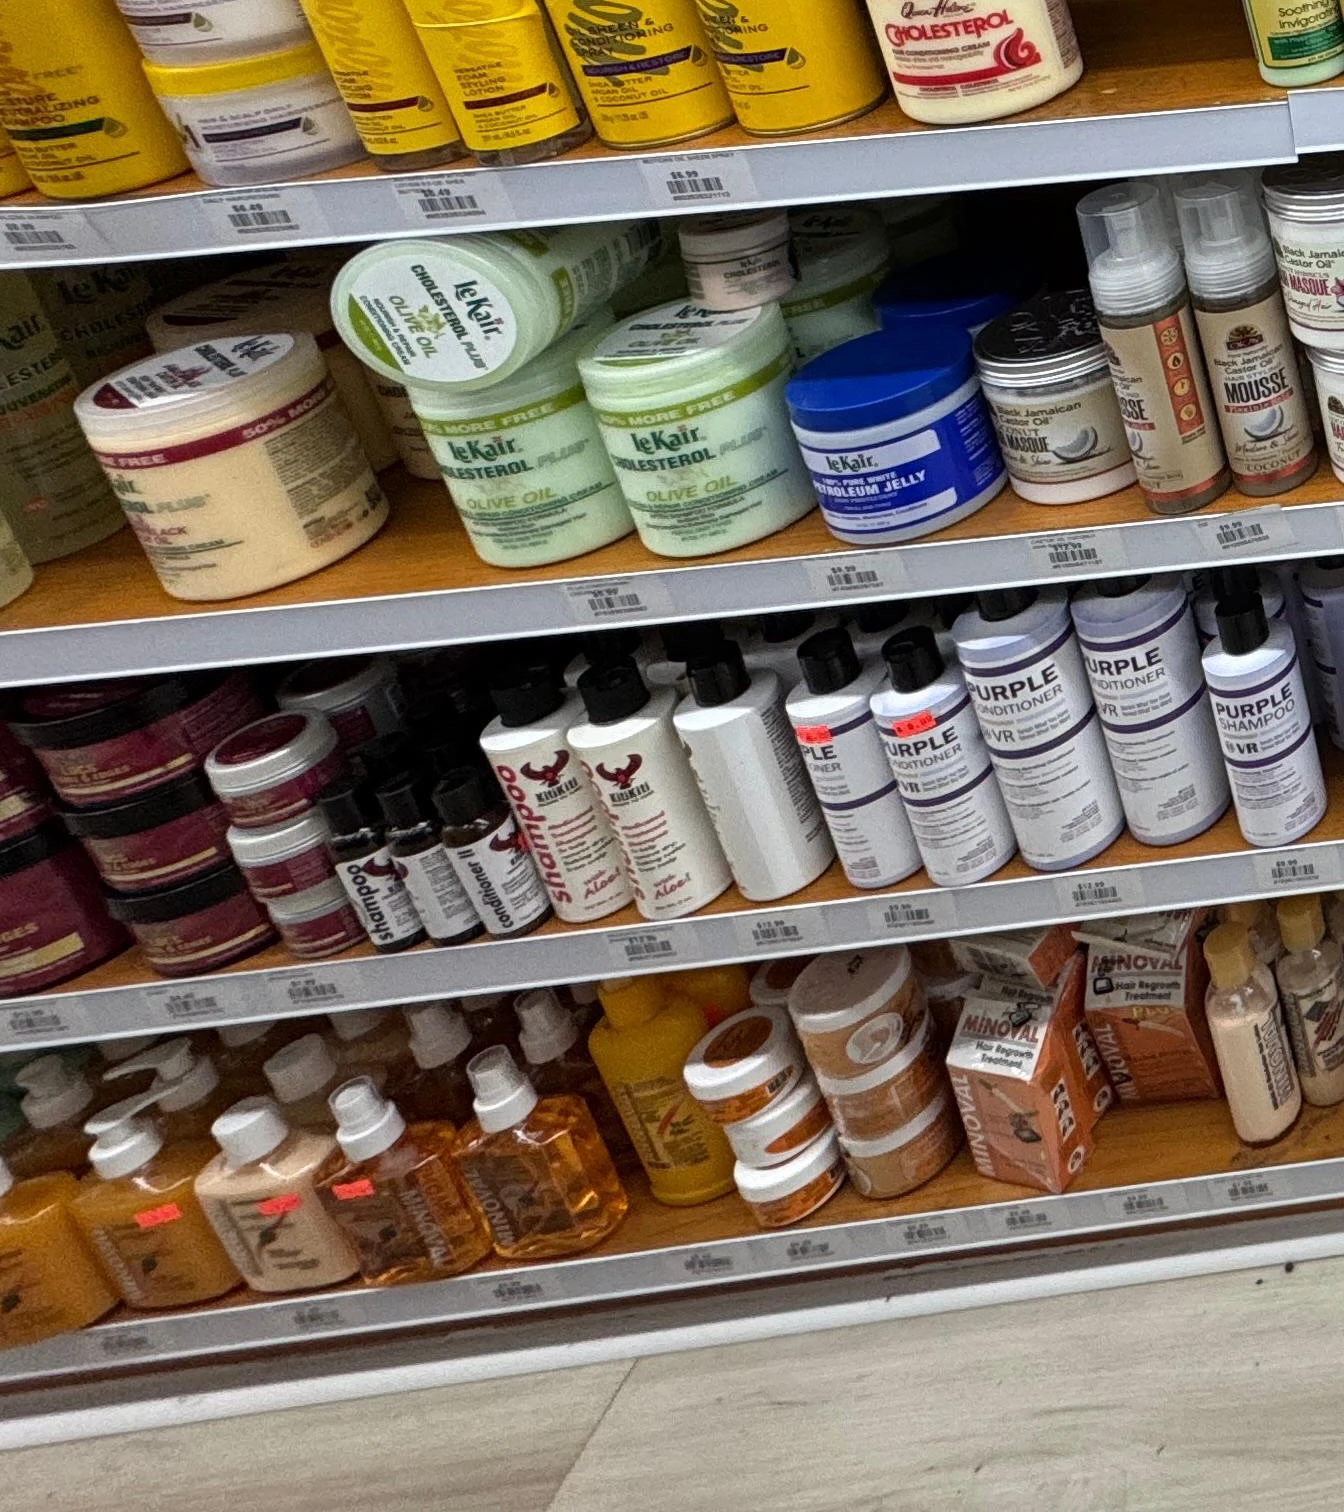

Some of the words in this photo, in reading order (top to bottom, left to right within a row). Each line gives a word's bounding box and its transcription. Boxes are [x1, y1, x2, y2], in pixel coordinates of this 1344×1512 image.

[886, 11, 1013, 43] CHOLESTEROL
[389, 295, 425, 334] OLIVE
[415, 332, 438, 359] OIL
[410, 263, 470, 341] CHOLESTEROL
[460, 340, 488, 371] PLUS
[498, 403, 555, 426] FREE
[813, 478, 880, 499] PETROLEUM
[884, 470, 926, 494] JELLY
[1215, 683, 1292, 718] PURPLE
[1219, 700, 1295, 732] SHAMPOO
[1237, 741, 1258, 755] VR
[348, 866, 394, 942] shampoo
[475, 860, 514, 927] conditioner
[961, 1014, 1039, 1044] MINOVAL
[981, 1055, 1023, 1067] Treatment
[954, 1074, 996, 1175] MINOVAL
